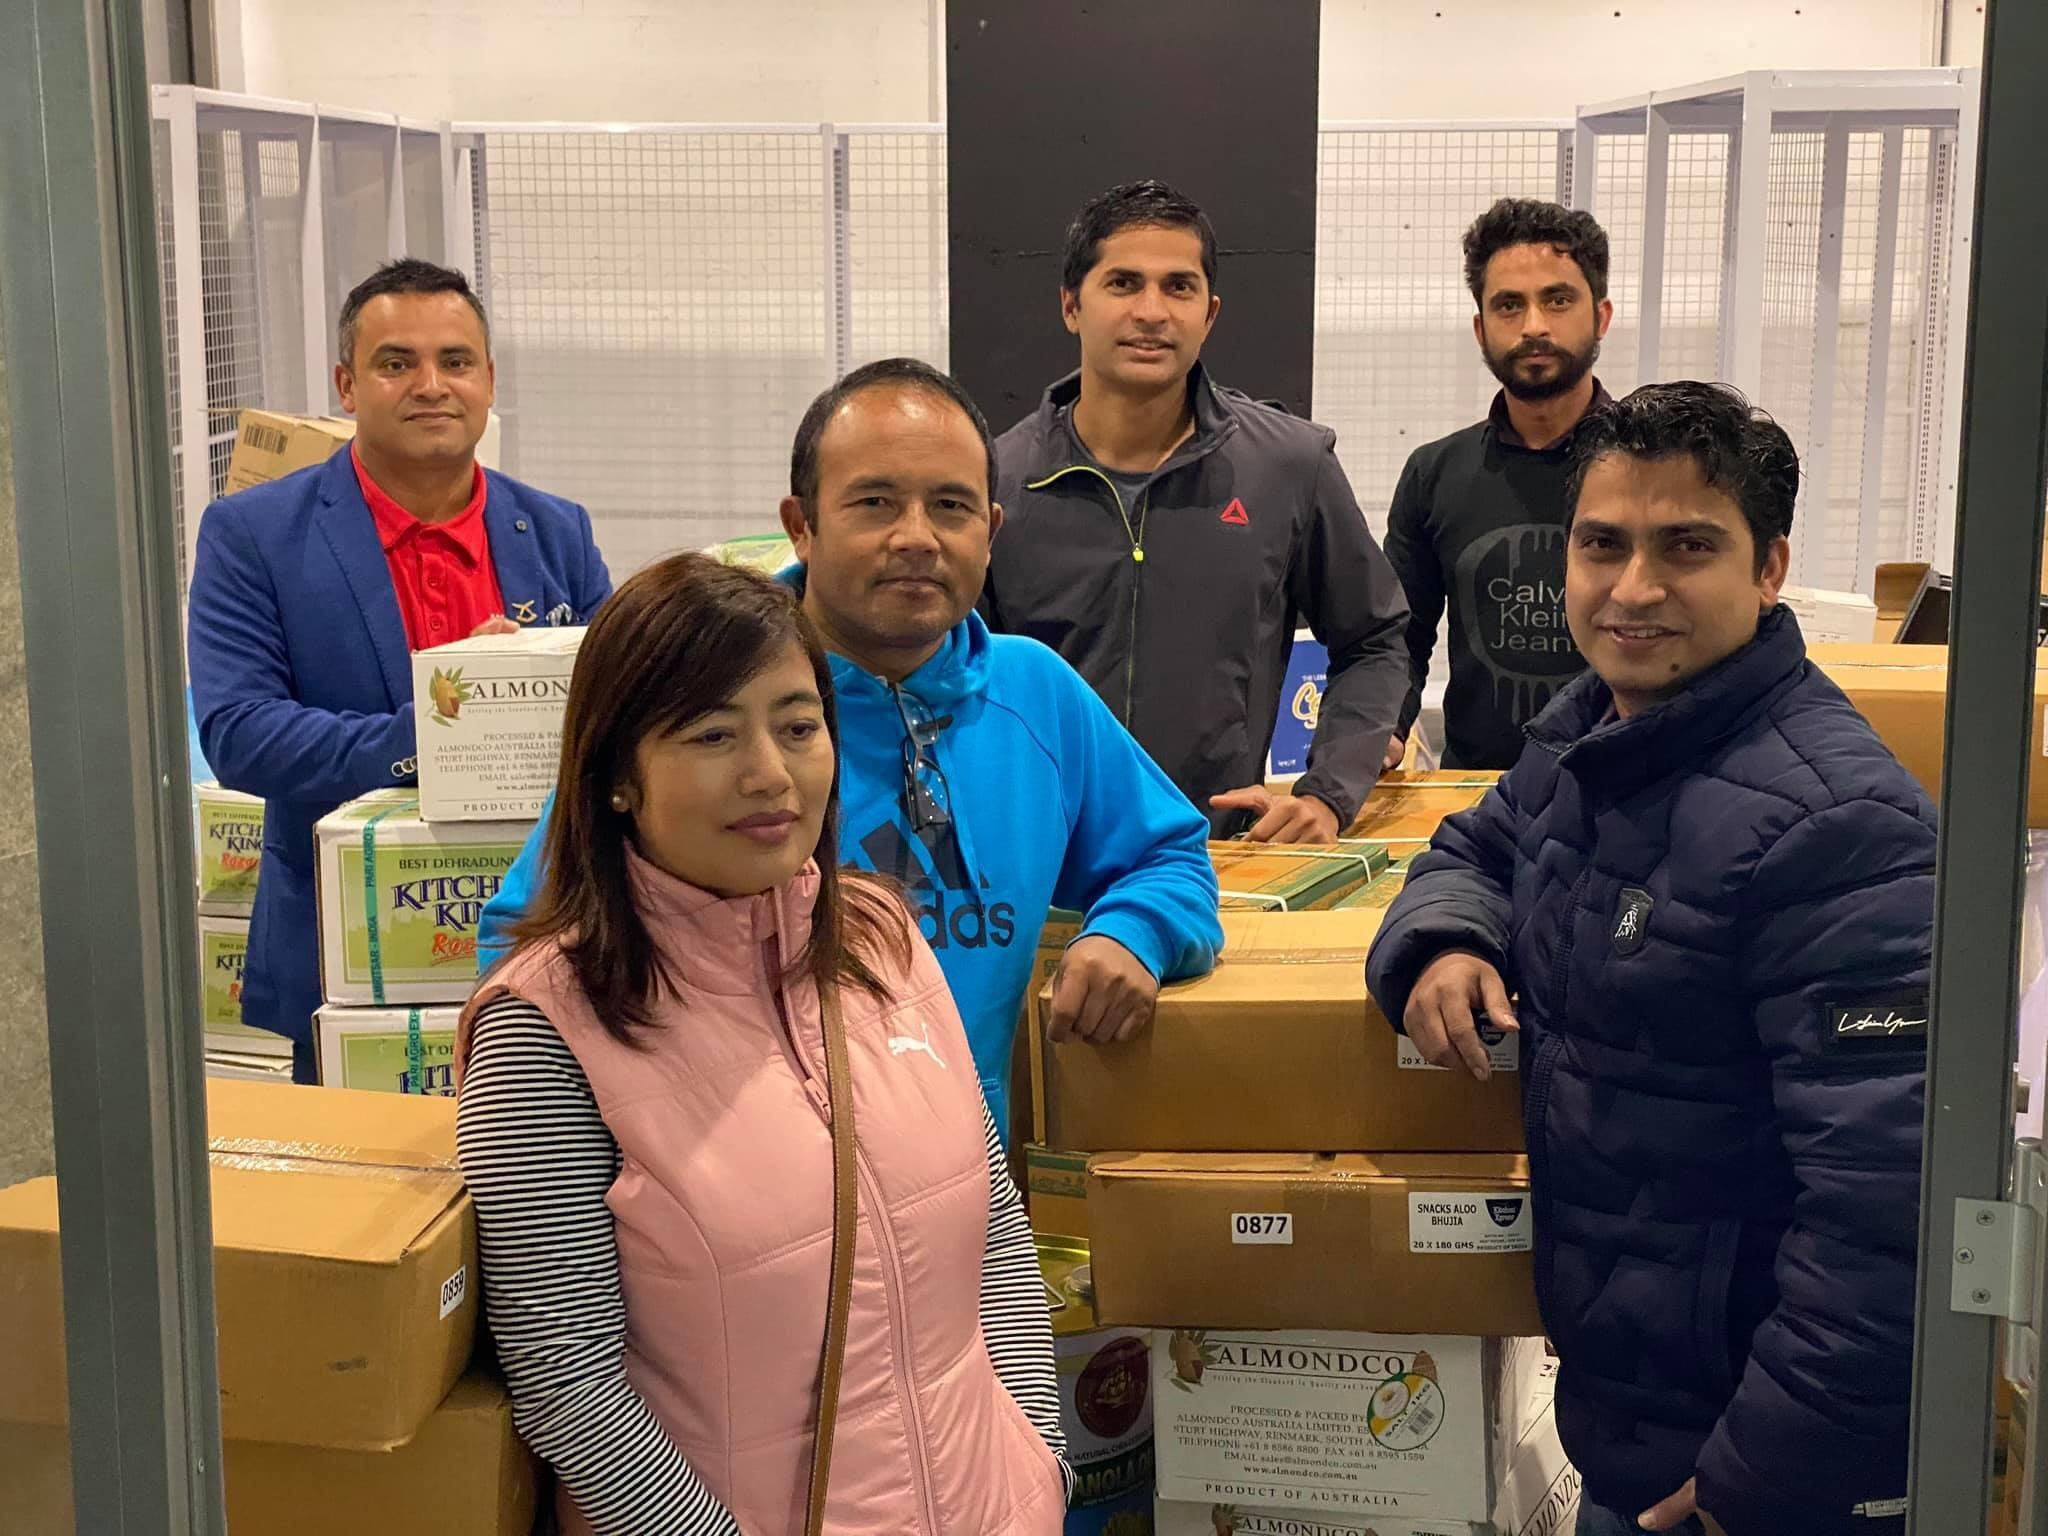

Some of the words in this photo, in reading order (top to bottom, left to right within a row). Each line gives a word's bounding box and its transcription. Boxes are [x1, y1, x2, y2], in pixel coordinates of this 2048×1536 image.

[1488, 578, 1565, 604] Calv
[1490, 629, 1571, 653] Jean
[472, 680, 569, 699] ALMON
[484, 732, 535, 741] PROCESSED
[437, 743, 492, 753] ALMONDCO
[494, 741, 546, 751] AUSTRALIA
[434, 754, 463, 763] STURT
[439, 764, 493, 773] TELEPHONE
[463, 802, 524, 811] PRODUCT
[399, 858, 430, 870] BEST
[1401, 1057, 1412, 1065] 20
[1417, 1203, 1452, 1214] SNACKS
[1453, 1204, 1477, 1214] ALOO
[1236, 1215, 1288, 1234] 0877
[1431, 1216, 1464, 1226] BHUJIA
[1413, 1241, 1424, 1249] 20
[1436, 1241, 1452, 1249] 180
[1454, 1241, 1475, 1249] GMS
[443, 1269, 464, 1306] 0859
[1217, 1346, 1405, 1376] ALMONDCO
[1230, 1405, 1292, 1418] PROCESSED
[1294, 1409, 1302, 1418] &
[1305, 1410, 1349, 1422] PACKED
[1176, 1413, 1240, 1425] ALMONDCO
[1242, 1417, 1303, 1430] AUSTRALIA
[1174, 1424, 1205, 1435] STURT
[1326, 1436, 1367, 1446] SOUTH
[1178, 1437, 1240, 1449] TELEPHONE
[1325, 1447, 1345, 1457] FAX
[1223, 1450, 1258, 1462] EMAIL
[1243, 1466, 1358, 1480] www.almondco.com.au
[1205, 1483, 1276, 1497] PRODUCT
[1284, 1489, 1302, 1499] OF
[1310, 1493, 1400, 1506] AUSTRALIA
